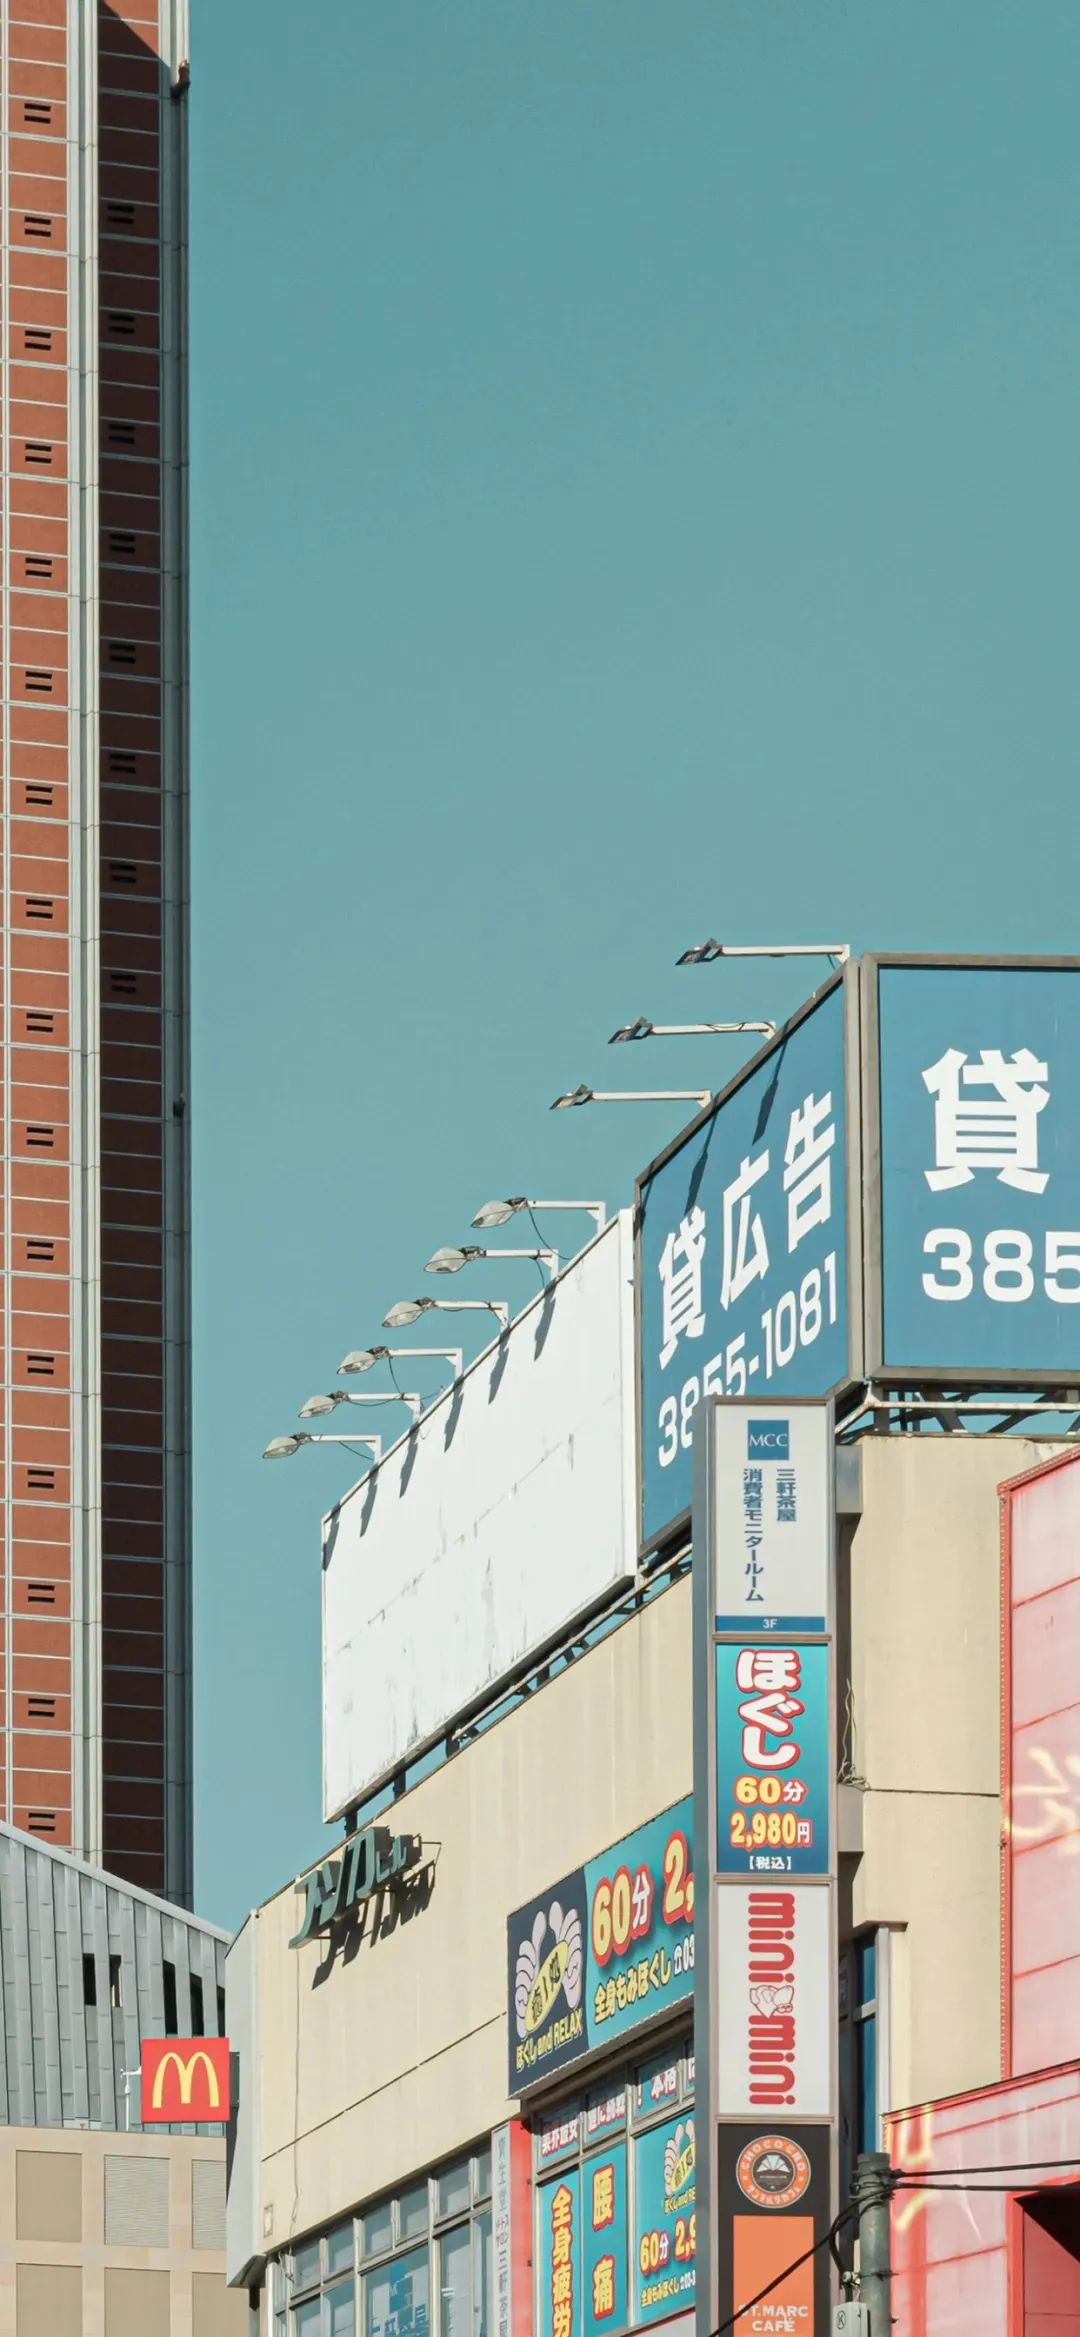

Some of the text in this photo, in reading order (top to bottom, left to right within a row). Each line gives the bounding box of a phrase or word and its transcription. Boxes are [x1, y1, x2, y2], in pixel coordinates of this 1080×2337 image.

[921, 1048, 1050, 1194] 貸
[658, 1090, 836, 1370] 貸広告
[921, 1227, 1080, 1303] 385
[749, 1434, 788, 1448] MCC
[776, 1468, 797, 1522] 三軒茶屋
[743, 1468, 765, 1602] 消費者モニタールーム
[763, 1618, 778, 1629] 3F
[736, 1649, 803, 1768] ほぐし
[735, 1776, 805, 1805] 60分
[731, 1812, 811, 1848] 2,980円
[592, 1868, 651, 1960] 60分
[594, 1946, 671, 2024] 全身もみほぐし
[747, 1892, 796, 2106] mini mini
[554, 2008, 583, 2048] RELAX
[592, 2165, 614, 2318] 腰痛
[640, 2231, 669, 2272] 60分
